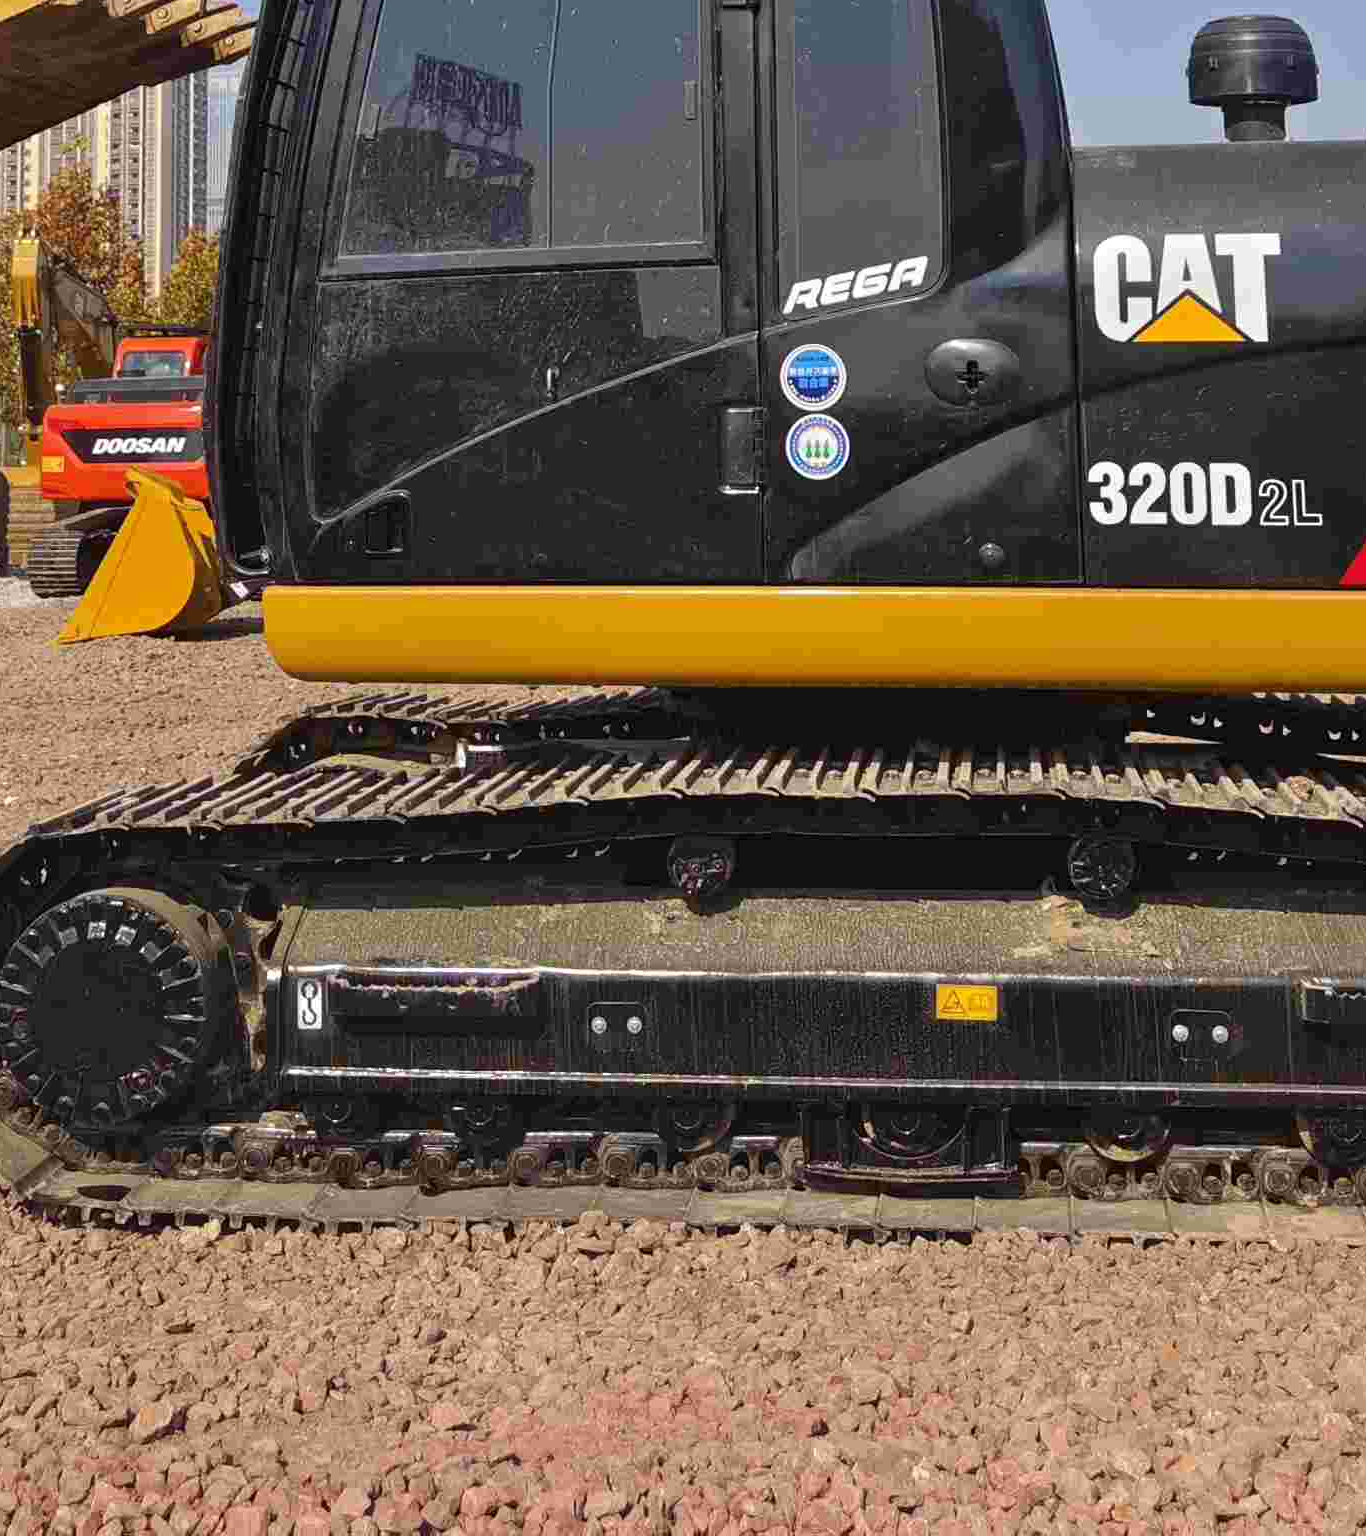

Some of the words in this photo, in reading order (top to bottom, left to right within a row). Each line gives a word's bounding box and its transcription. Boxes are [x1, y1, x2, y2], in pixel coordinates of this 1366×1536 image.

[783, 256, 928, 314] REGA
[1093, 233, 1281, 342] CAT
[92, 437, 187, 454] DOOSAN
